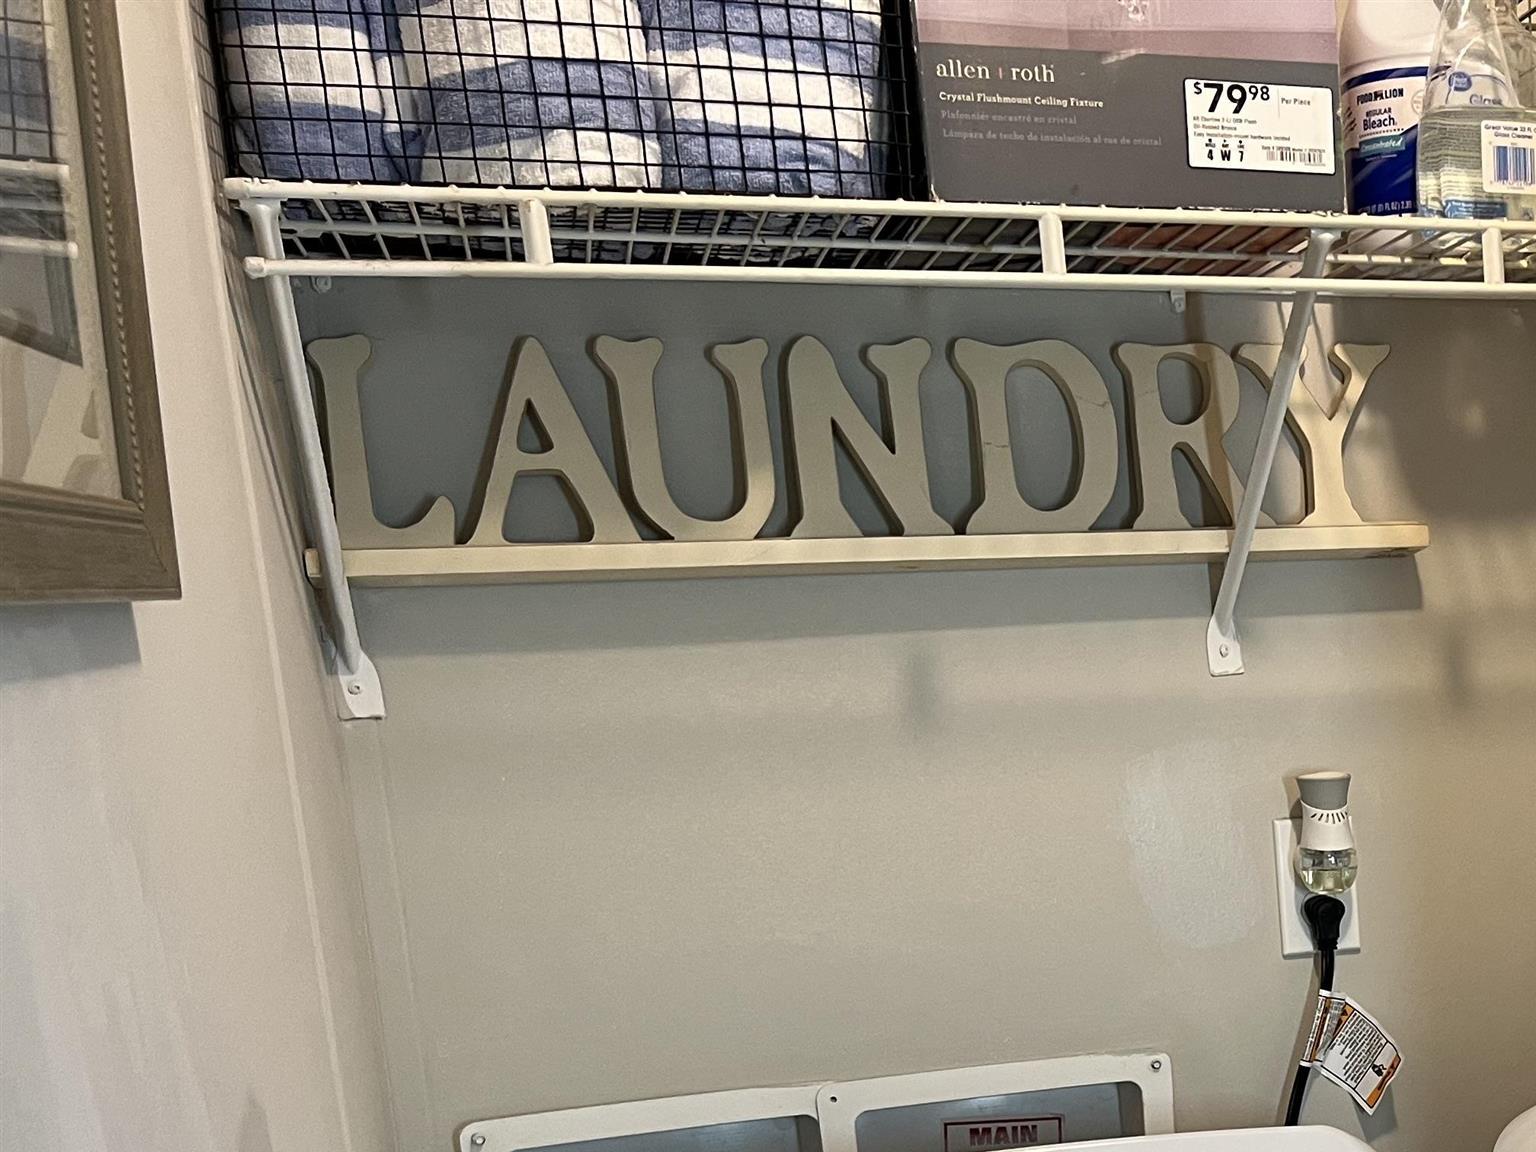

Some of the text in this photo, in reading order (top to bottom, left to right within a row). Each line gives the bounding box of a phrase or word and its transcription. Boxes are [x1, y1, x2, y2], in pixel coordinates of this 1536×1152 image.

[936, 59, 990, 79] allen
[1010, 64, 1055, 83] roth
[939, 91, 1104, 108] Crystal Flushmount Ceiling Fixture
[1385, 88, 1404, 99] LION
[1293, 98, 1311, 106] Piece
[1048, 114, 1077, 125] cristal
[1363, 115, 1395, 131] Bleach
[986, 130, 997, 139] de
[1027, 133, 1038, 142] de
[1207, 149, 1214, 161] 4
[1221, 149, 1231, 161] W
[1239, 150, 1244, 162] 7
[306, 334, 1392, 548] LAUNDRY
[969, 1124, 1038, 1147] MAIN
